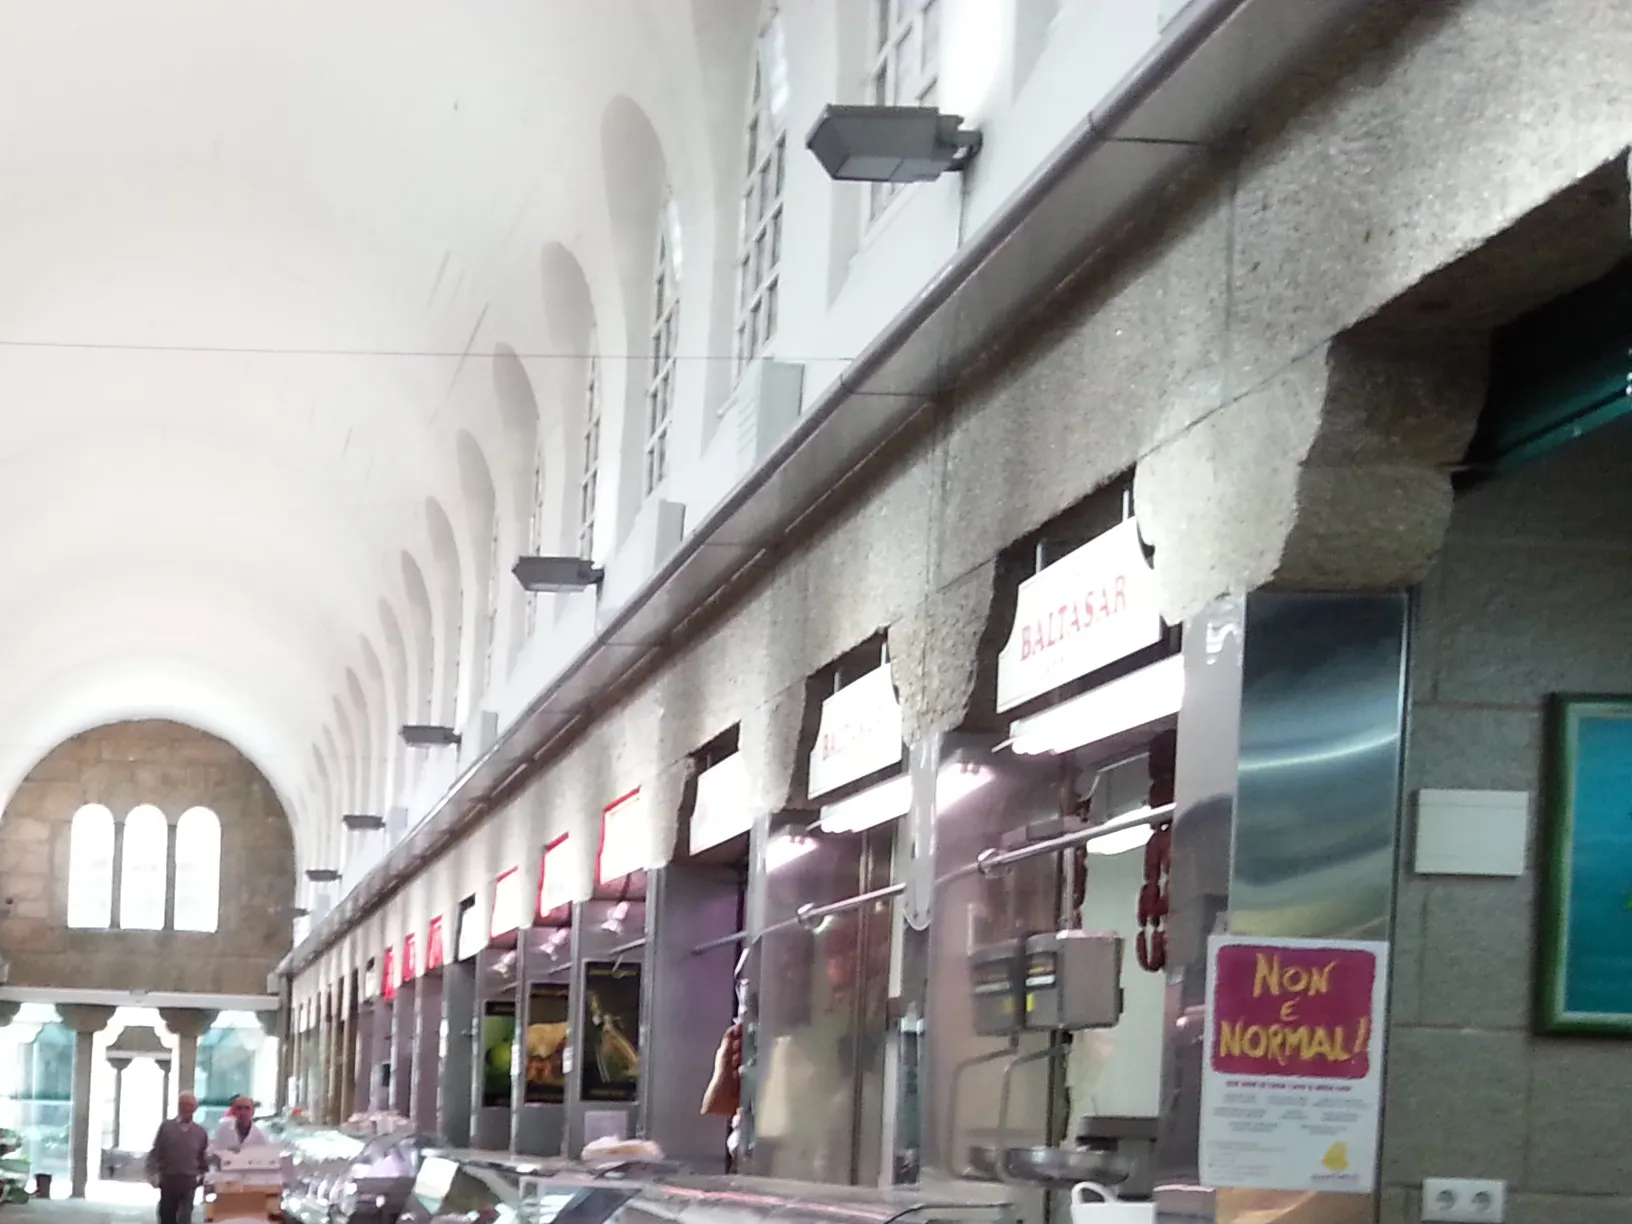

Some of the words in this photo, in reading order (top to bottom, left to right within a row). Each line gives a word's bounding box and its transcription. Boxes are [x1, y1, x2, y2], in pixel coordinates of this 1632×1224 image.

[1020, 574, 1128, 662] BALTASAR
[1252, 952, 1341, 998] NON
[1219, 1015, 1369, 1067] NORMAL!
